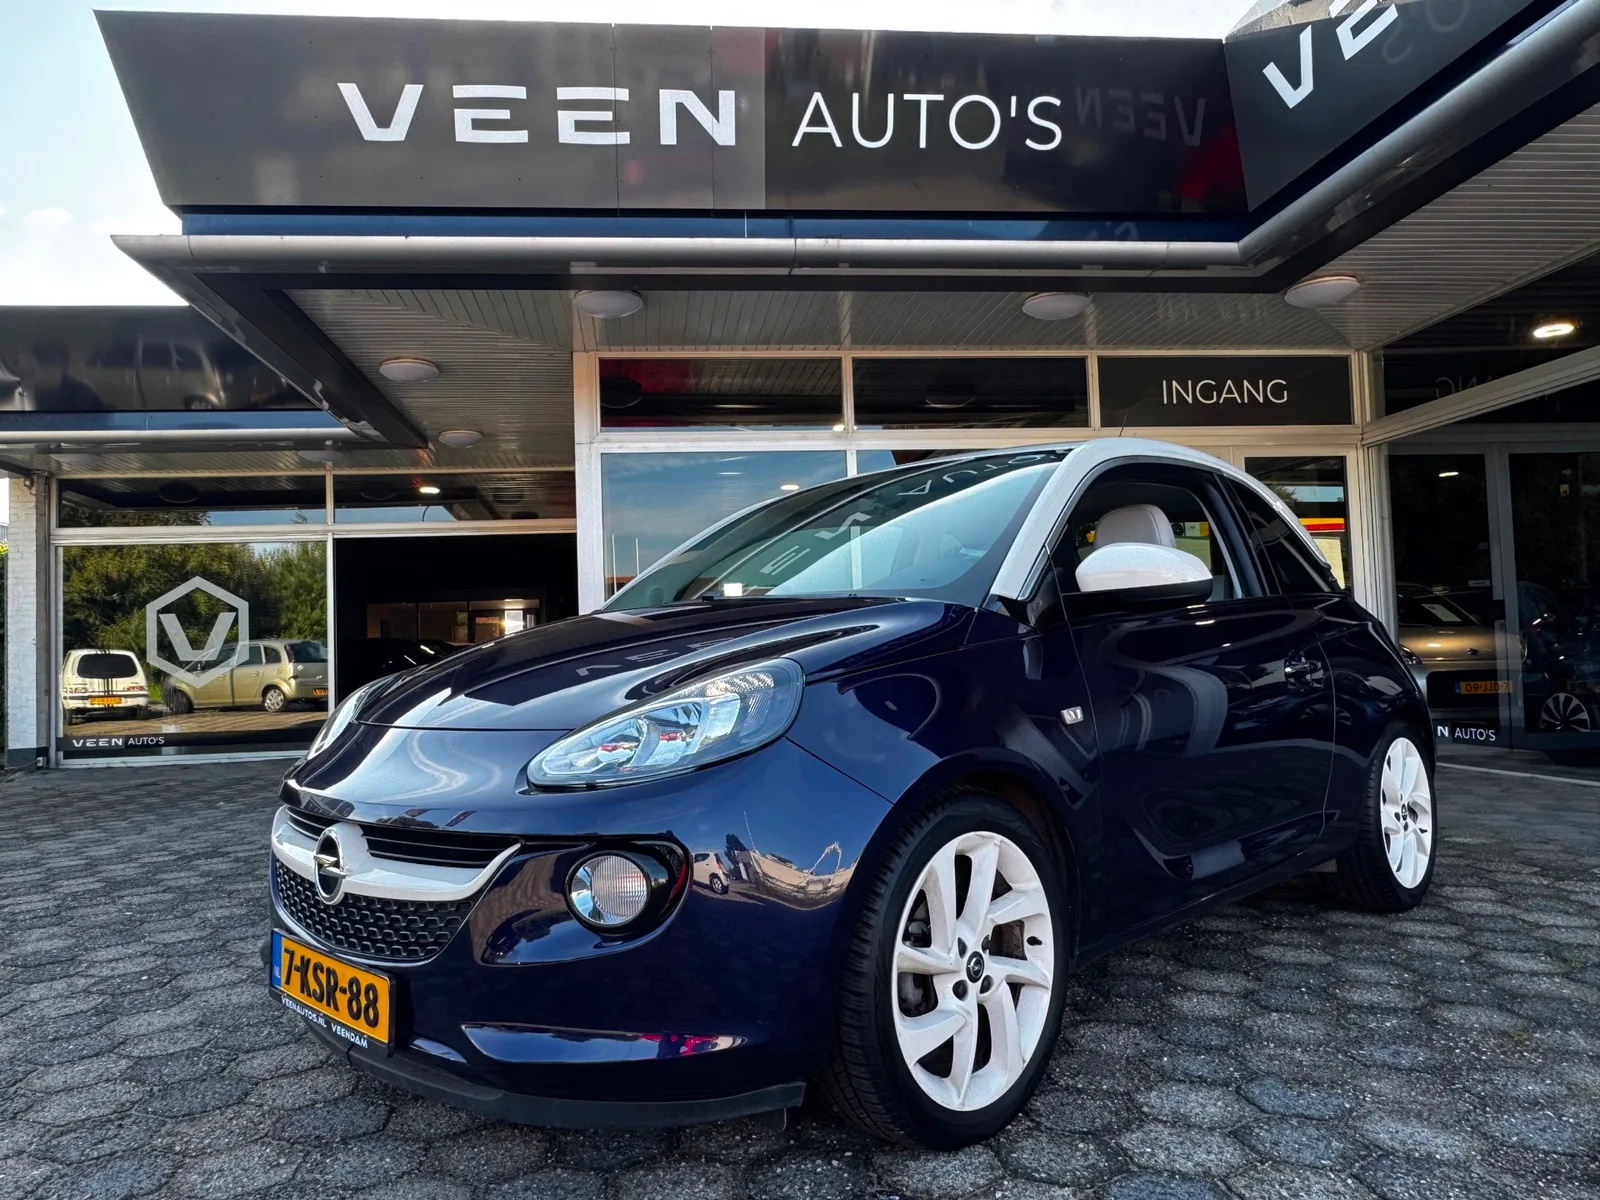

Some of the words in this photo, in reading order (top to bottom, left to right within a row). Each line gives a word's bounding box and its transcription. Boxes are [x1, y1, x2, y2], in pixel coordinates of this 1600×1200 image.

[337, 82, 736, 146] VEEN
[791, 91, 1062, 151] AUTO'S
[1162, 378, 1289, 405] INGANG
[72, 738, 123, 747] VEEN
[127, 736, 165, 746] AUTO'S
[1454, 727, 1496, 742] AUTO'S
[284, 946, 380, 1029] 7-KSR-88
[281, 995, 327, 1028] VEENAUTOS.NL
[331, 1022, 369, 1049] VEENDAM
